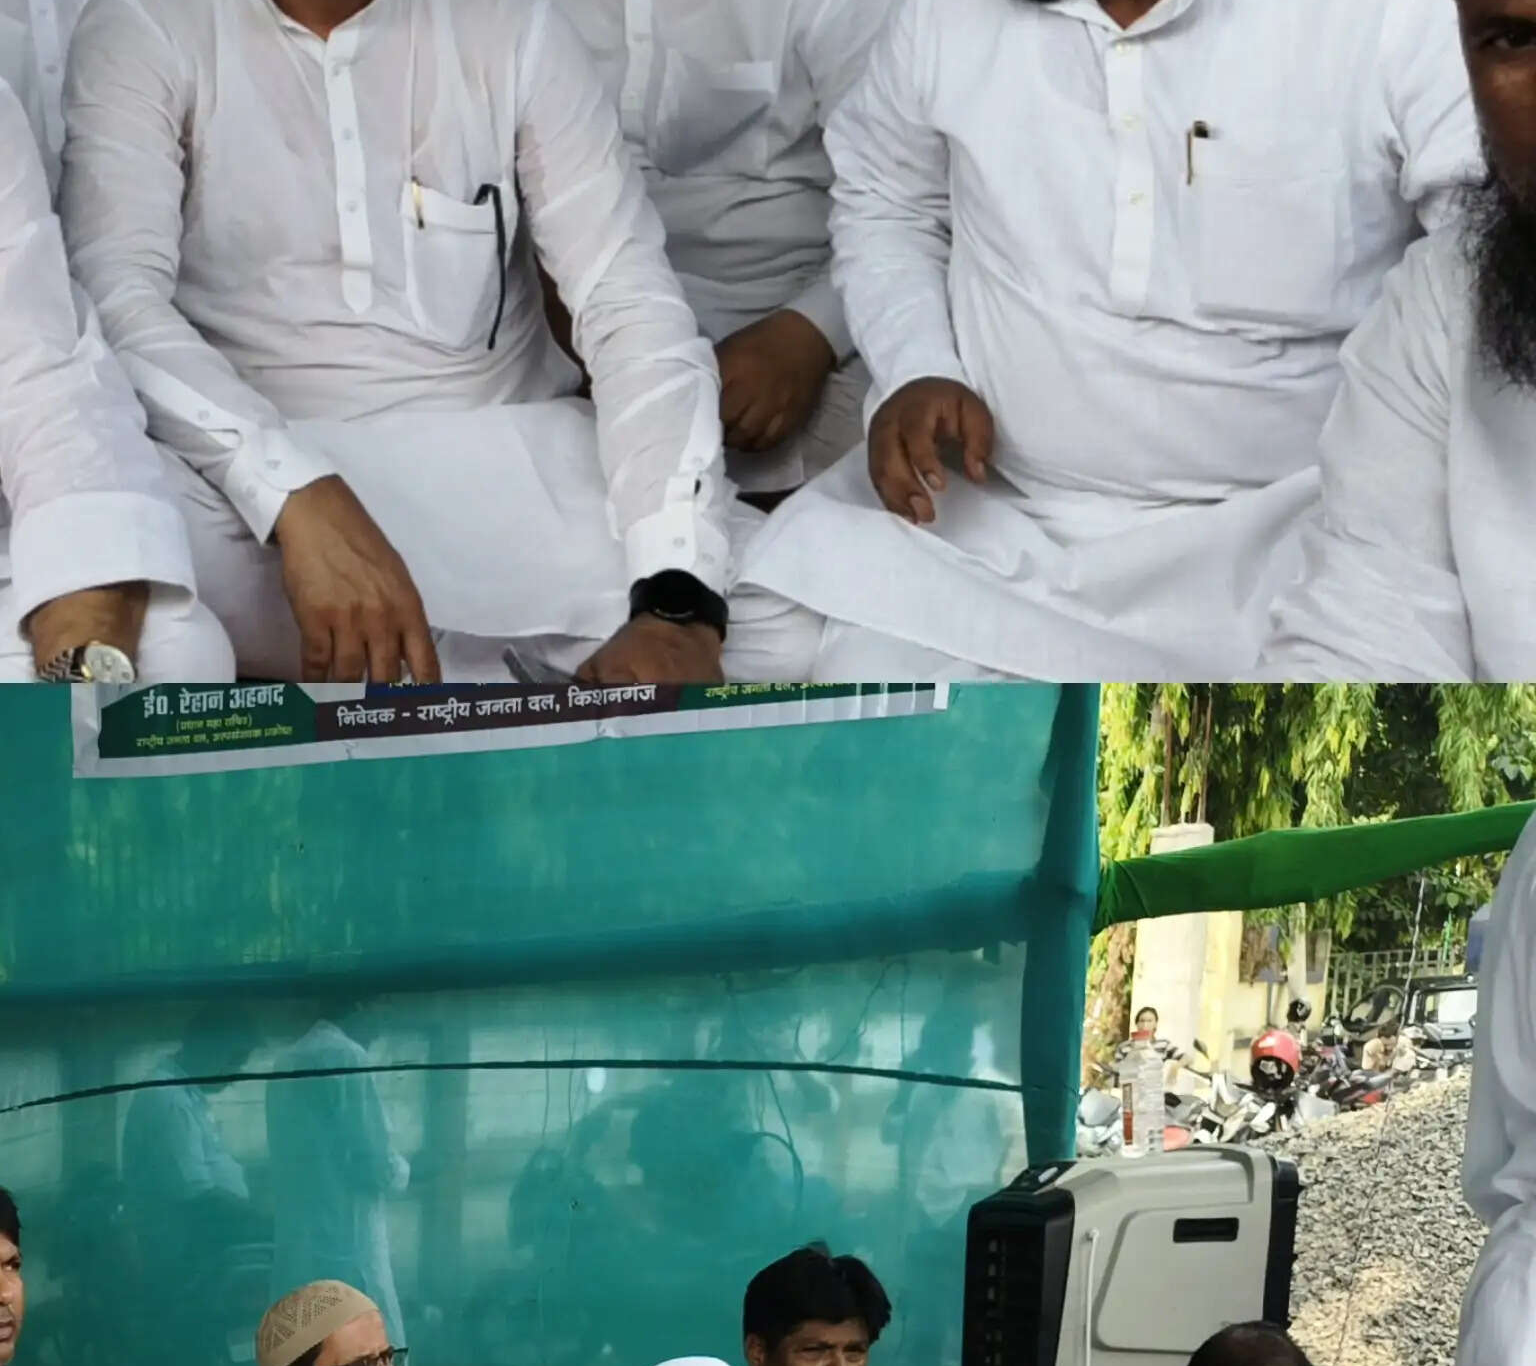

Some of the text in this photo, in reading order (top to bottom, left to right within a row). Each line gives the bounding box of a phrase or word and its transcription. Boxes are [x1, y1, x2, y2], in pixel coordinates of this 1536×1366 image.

[337, 705, 396, 728] निवेदक
[416, 697, 471, 725] राष्ट्रीय
[476, 696, 523, 715] जनता
[567, 683, 657, 709] किशनगंज
